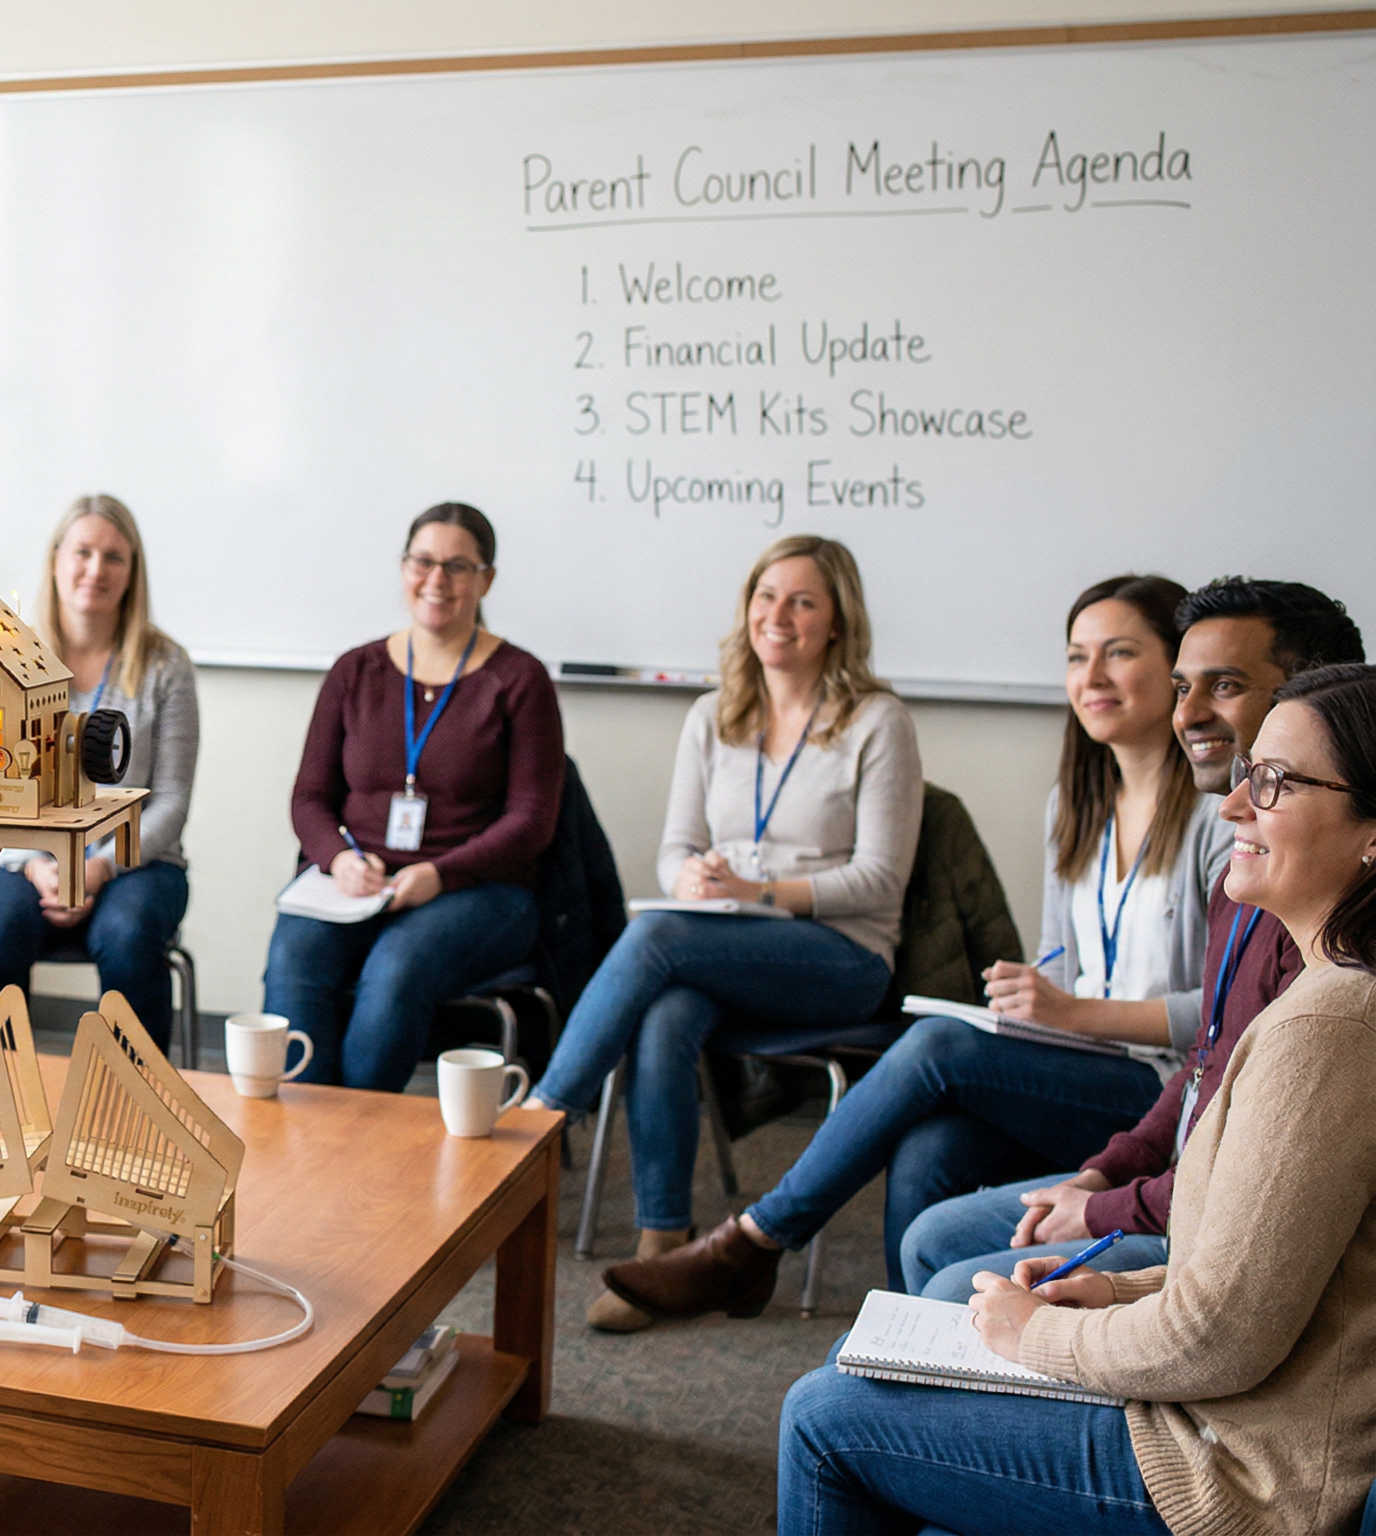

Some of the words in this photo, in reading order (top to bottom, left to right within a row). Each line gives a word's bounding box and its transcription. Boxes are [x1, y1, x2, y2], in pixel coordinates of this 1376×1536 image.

[523, 152, 652, 215] Parent
[674, 144, 816, 207] Council
[845, 139, 1006, 219] Meeting
[1031, 129, 1193, 213] Agenda
[581, 265, 598, 305] 1.
[618, 260, 783, 305] Welcome
[574, 330, 605, 369] 2.
[625, 323, 777, 368] Financial
[801, 319, 933, 378] Update
[574, 393, 607, 436] 3.
[625, 390, 738, 436] STEM
[760, 390, 829, 436] Kits
[849, 388, 1034, 441] Showcase
[574, 459, 608, 503] 4.
[626, 458, 784, 528] Upcoming
[806, 458, 926, 510] Events
